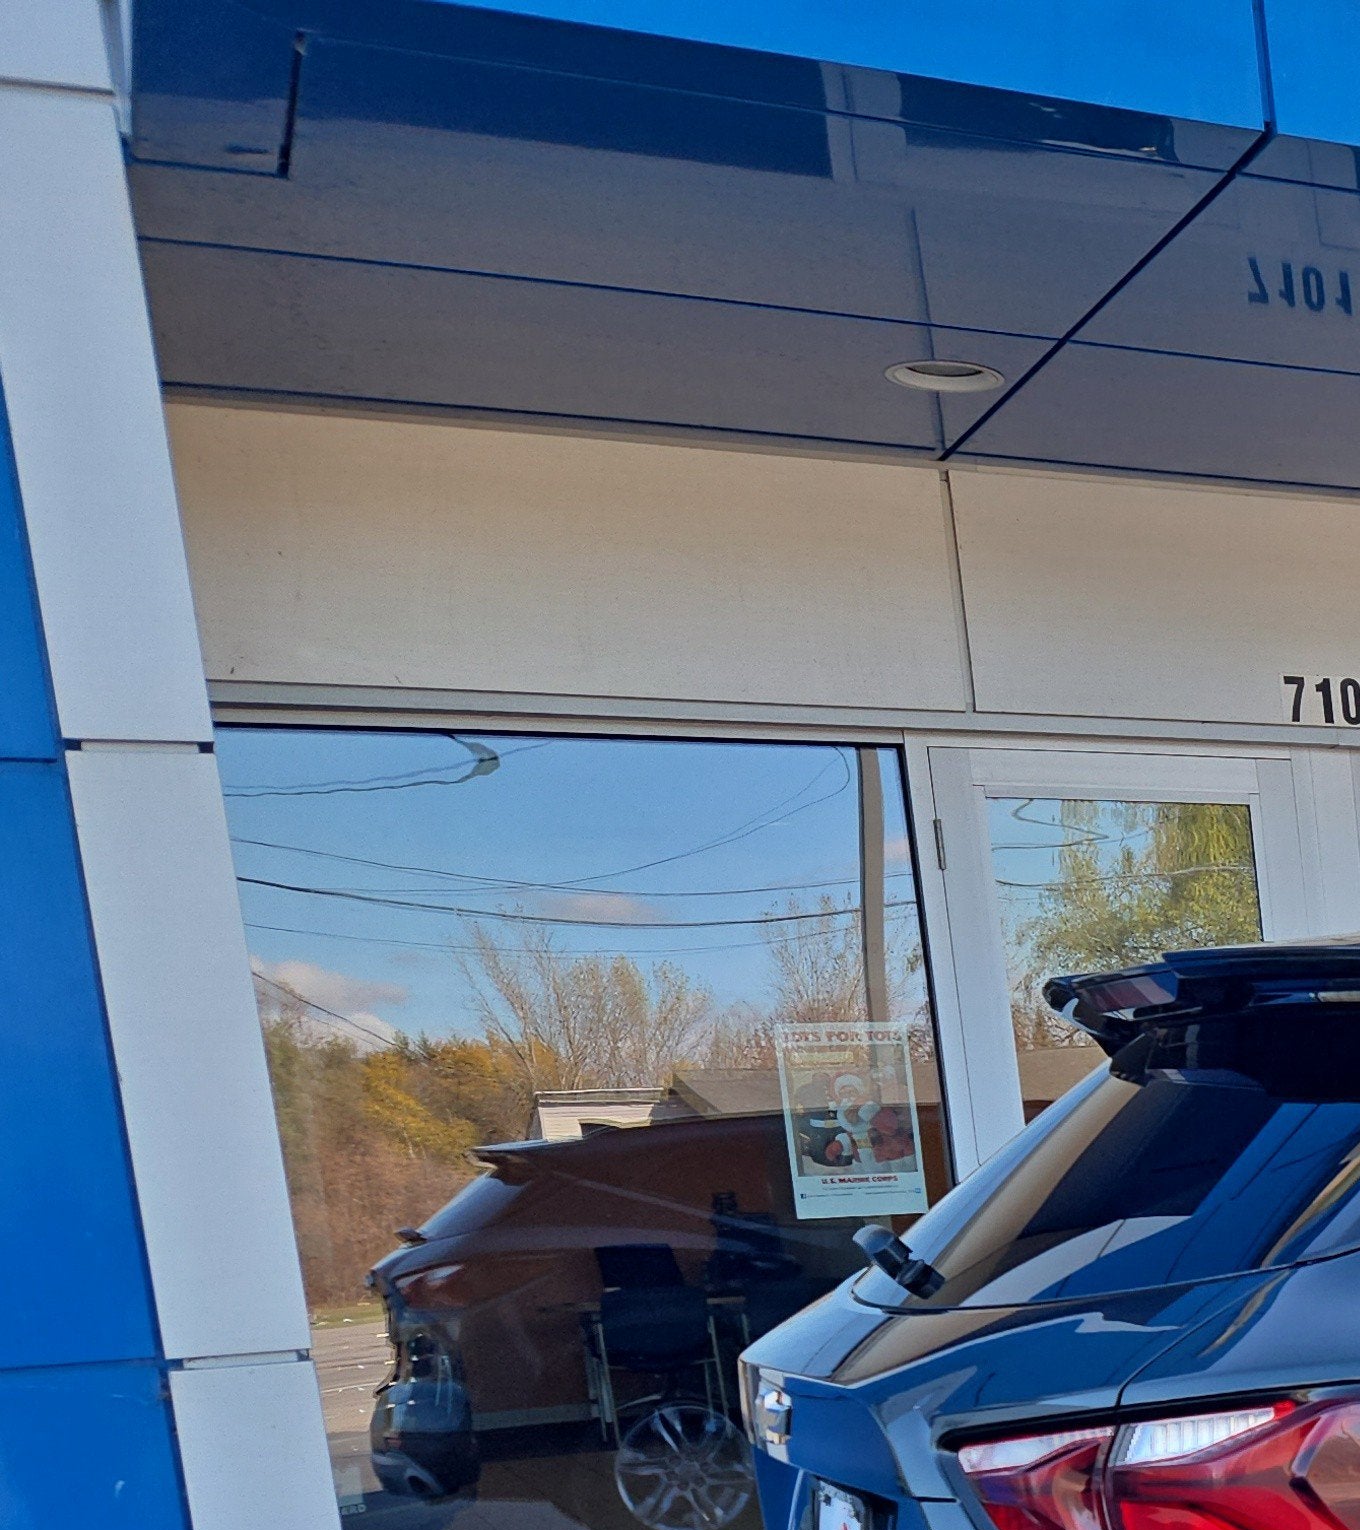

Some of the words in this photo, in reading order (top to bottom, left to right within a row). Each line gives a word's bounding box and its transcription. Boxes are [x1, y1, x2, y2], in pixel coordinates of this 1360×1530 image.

[782, 1030, 820, 1042] TOYS
[825, 1030, 861, 1042] FOR
[865, 1030, 901, 1041] TOTS
[838, 1176, 870, 1184] MARINE
